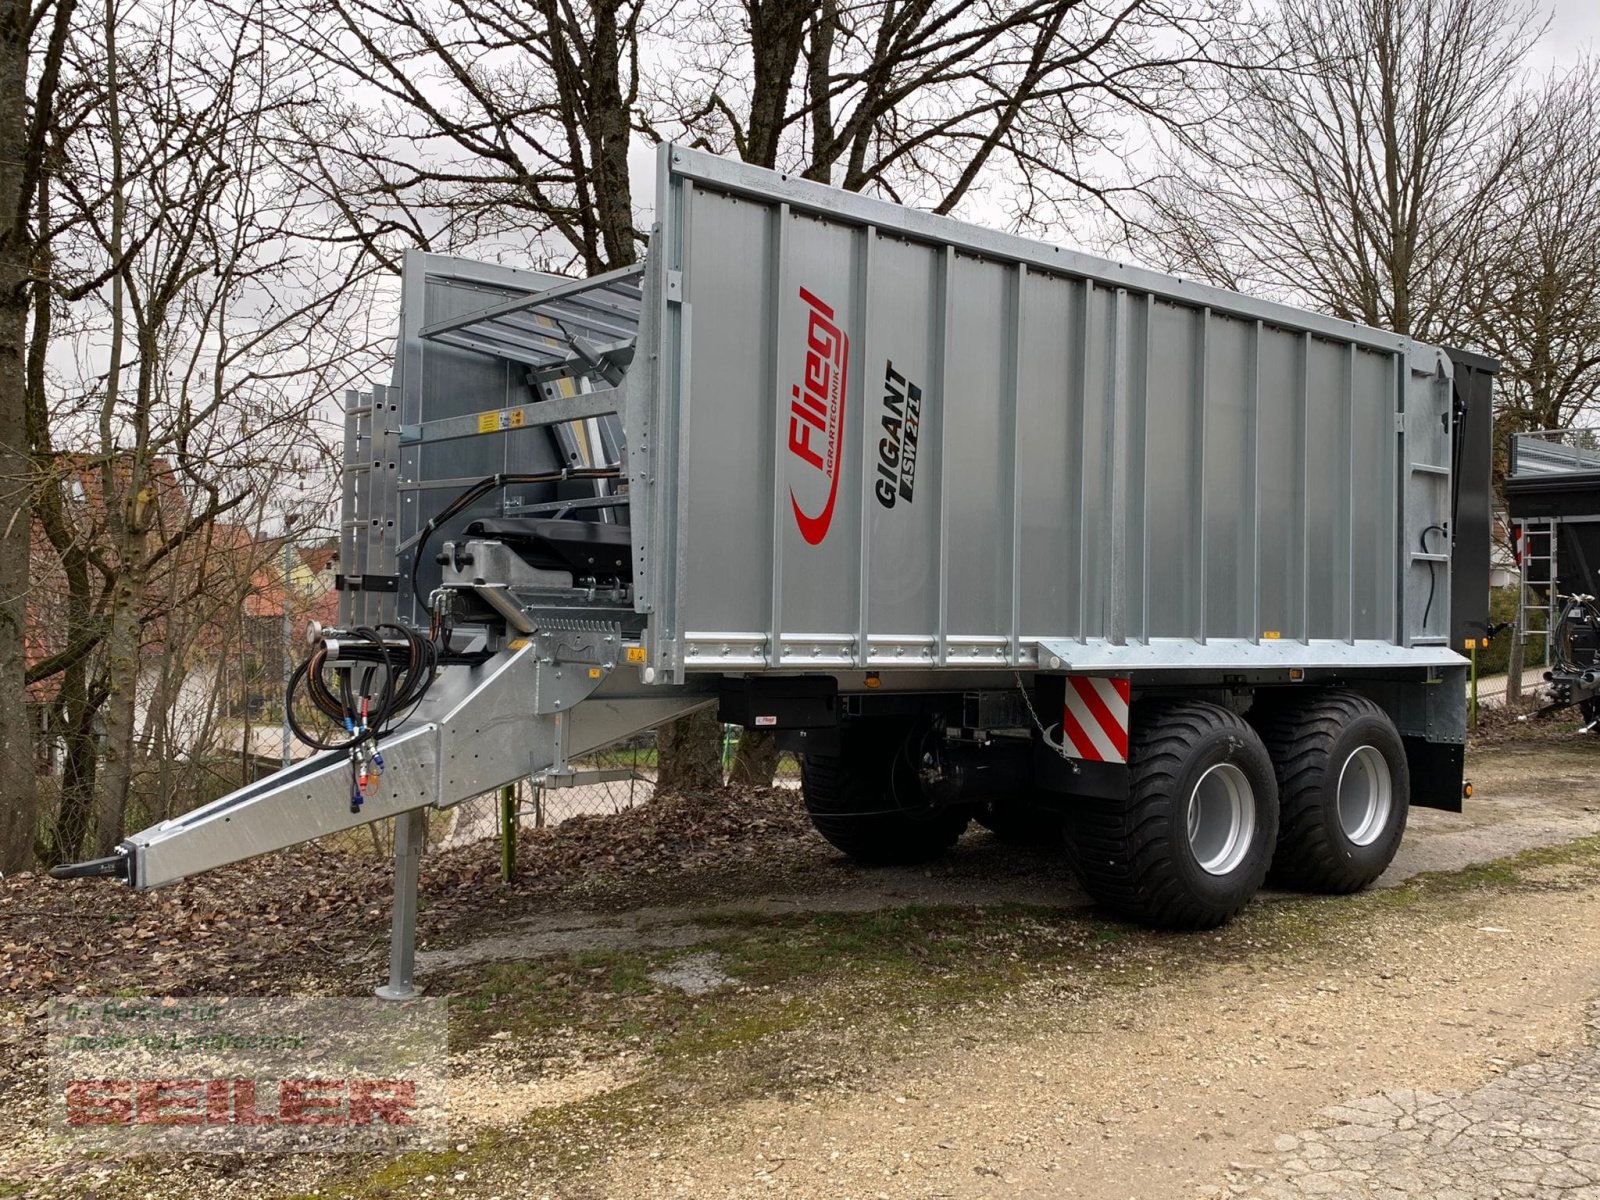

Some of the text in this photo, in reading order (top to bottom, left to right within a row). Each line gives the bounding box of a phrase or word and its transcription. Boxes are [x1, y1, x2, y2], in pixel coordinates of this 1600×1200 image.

[788, 285, 842, 471] Fliegl
[826, 369, 840, 479] AGRARTECHNIK
[875, 358, 907, 509] GIGANT
[901, 397, 920, 489] ASW 271
